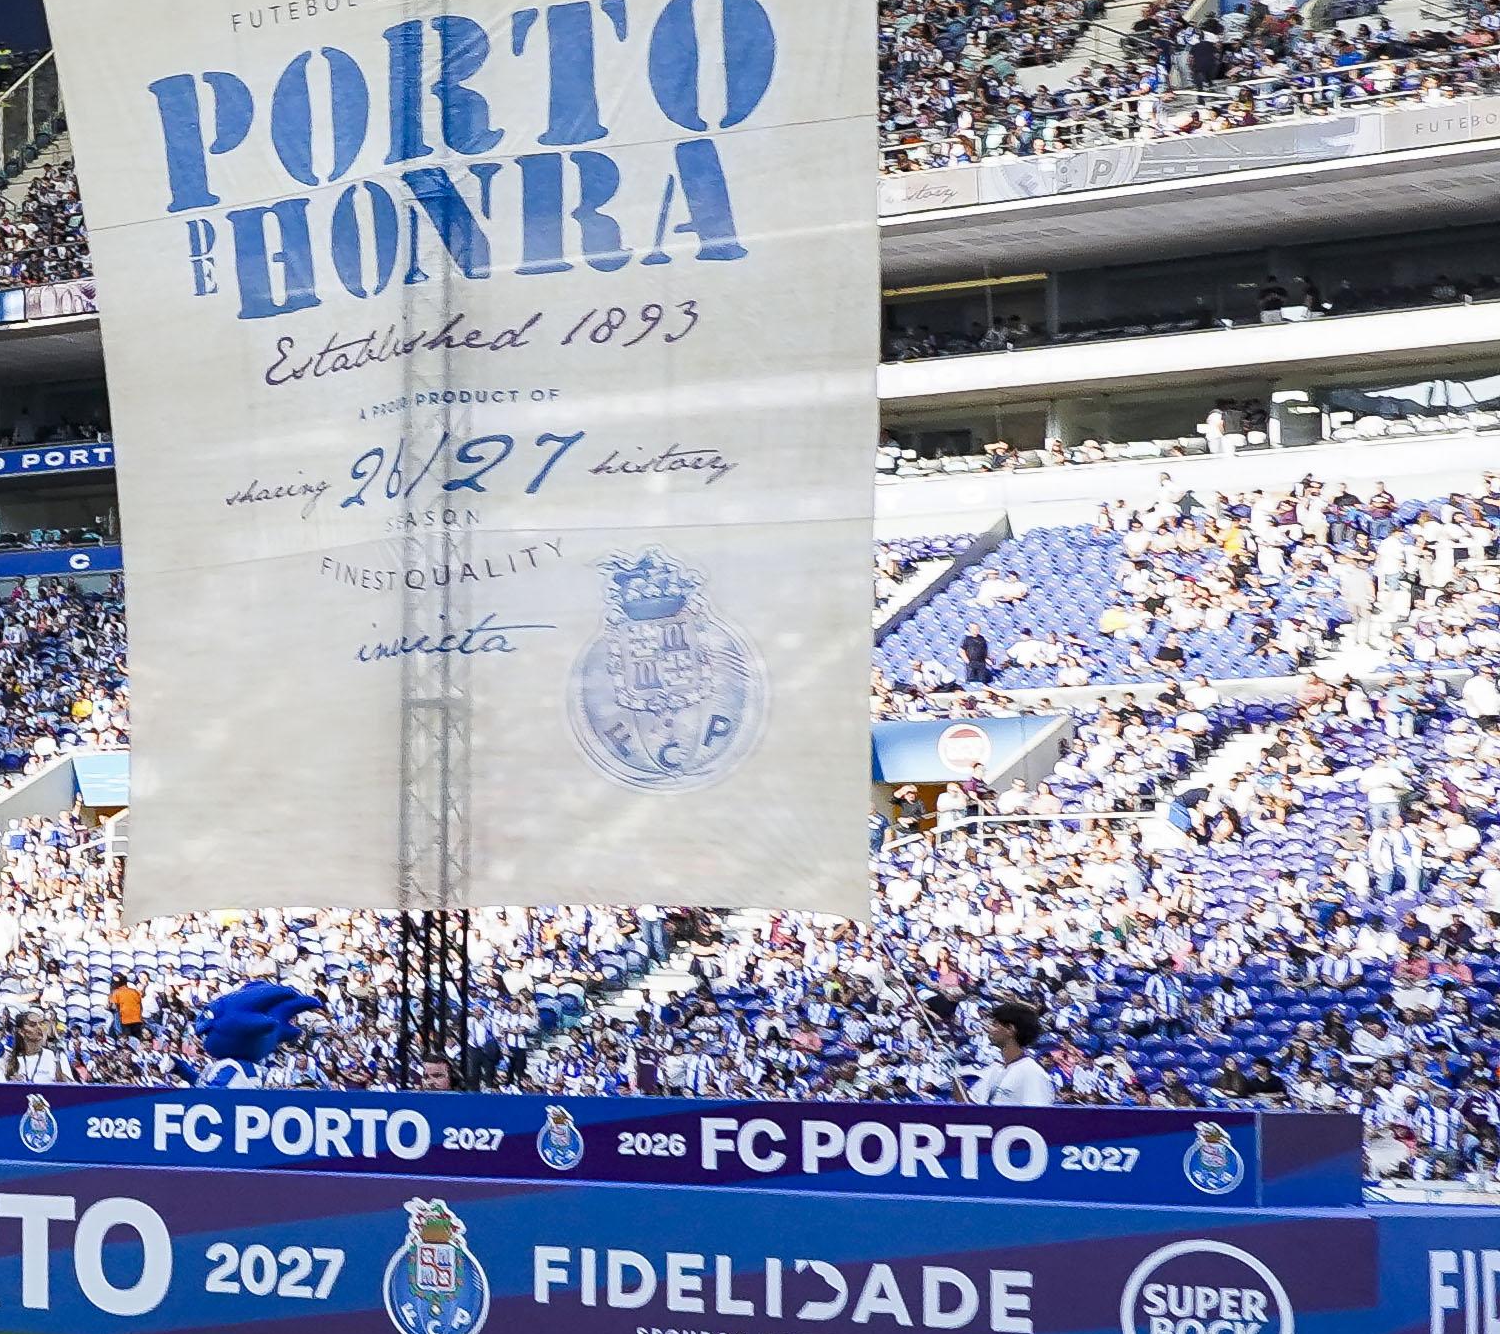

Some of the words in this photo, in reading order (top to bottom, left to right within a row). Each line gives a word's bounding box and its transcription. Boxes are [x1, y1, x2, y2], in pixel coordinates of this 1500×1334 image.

[224, 138, 750, 320] HONRA
[265, 312, 545, 386] Established
[560, 301, 701, 348] 1893
[414, 389, 521, 408] PRODUCT
[530, 389, 561, 403] OF
[21, 446, 114, 470] PORT
[340, 429, 586, 509] 26/27
[588, 442, 739, 480] history
[385, 508, 481, 532] SEASON
[319, 556, 398, 592] FINEST
[404, 537, 567, 592] QUALITY
[354, 612, 558, 664] invicta
[85, 1116, 142, 1141] 2026
[153, 1103, 223, 1154] FC
[235, 1108, 432, 1161] PORTO
[442, 1125, 504, 1152] 2027
[616, 1131, 687, 1157] 2026
[700, 1117, 788, 1174] FC
[801, 1120, 1049, 1182] PORTO
[1060, 1143, 1141, 1174] 2027
[204, 1242, 345, 1300] 2027
[533, 1244, 1035, 1334] FIDELIDADE
[1141, 1283, 1270, 1324] SUPER
